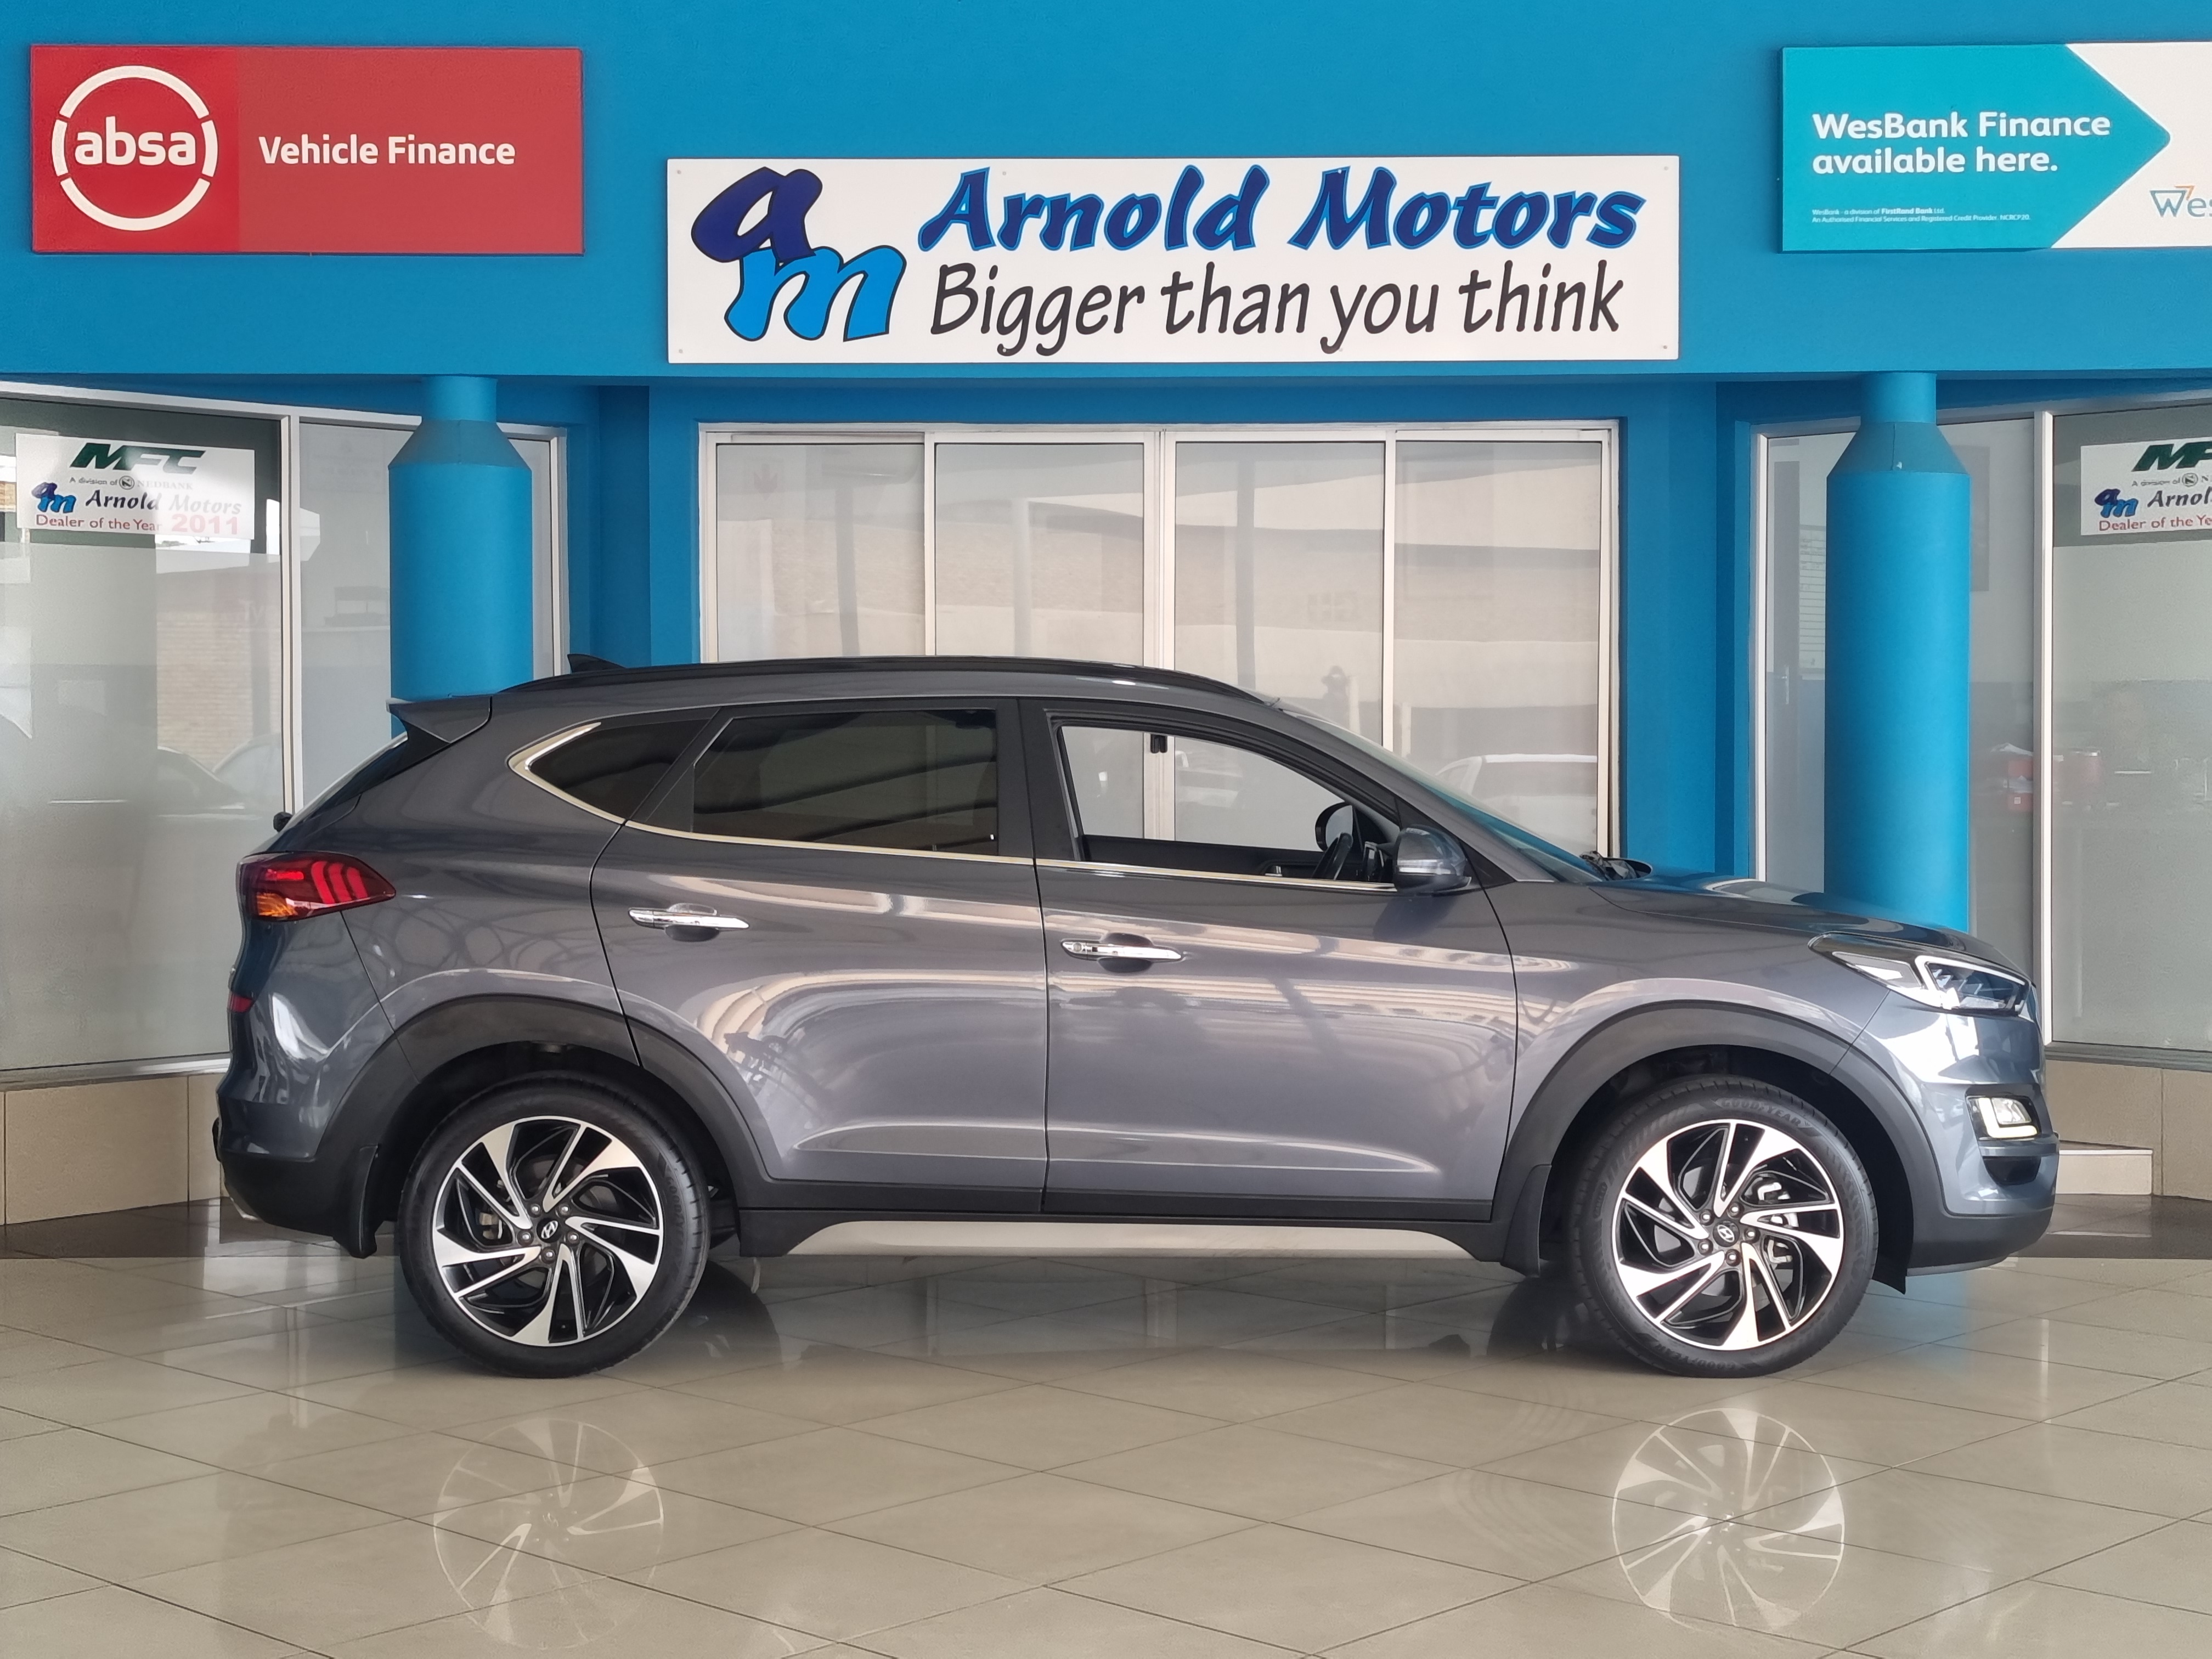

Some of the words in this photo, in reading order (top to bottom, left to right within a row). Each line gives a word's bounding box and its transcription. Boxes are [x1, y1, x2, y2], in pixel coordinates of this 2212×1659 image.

[1812, 112, 1968, 139] WesBank
[1978, 111, 2111, 137] Finance
[75, 116, 196, 166] absa
[258, 133, 379, 165] Vehicle
[388, 134, 516, 165] Finance
[1812, 147, 1965, 174] available
[1976, 146, 2058, 172] here.
[918, 165, 1270, 251] Arnold
[1287, 166, 1647, 250] Motors
[2149, 190, 2212, 217] We
[930, 262, 1146, 356] Bigger
[1160, 261, 1310, 334] than
[1320, 283, 1439, 354] you
[1458, 259, 1624, 334] think
[69, 442, 206, 475] MFC
[137, 480, 193, 490] NEDBANK
[2147, 486, 2212, 507] Arnol
[86, 489, 161, 511] Arnold
[168, 494, 242, 515] Motors
[36, 514, 84, 527] Dealer
[89, 518, 105, 529] of
[108, 518, 131, 531] the
[133, 518, 161, 532] Year
[171, 514, 238, 535] 2011
[2099, 518, 2146, 532] Dealer
[2151, 517, 2166, 528] of
[2170, 516, 2193, 528] the
